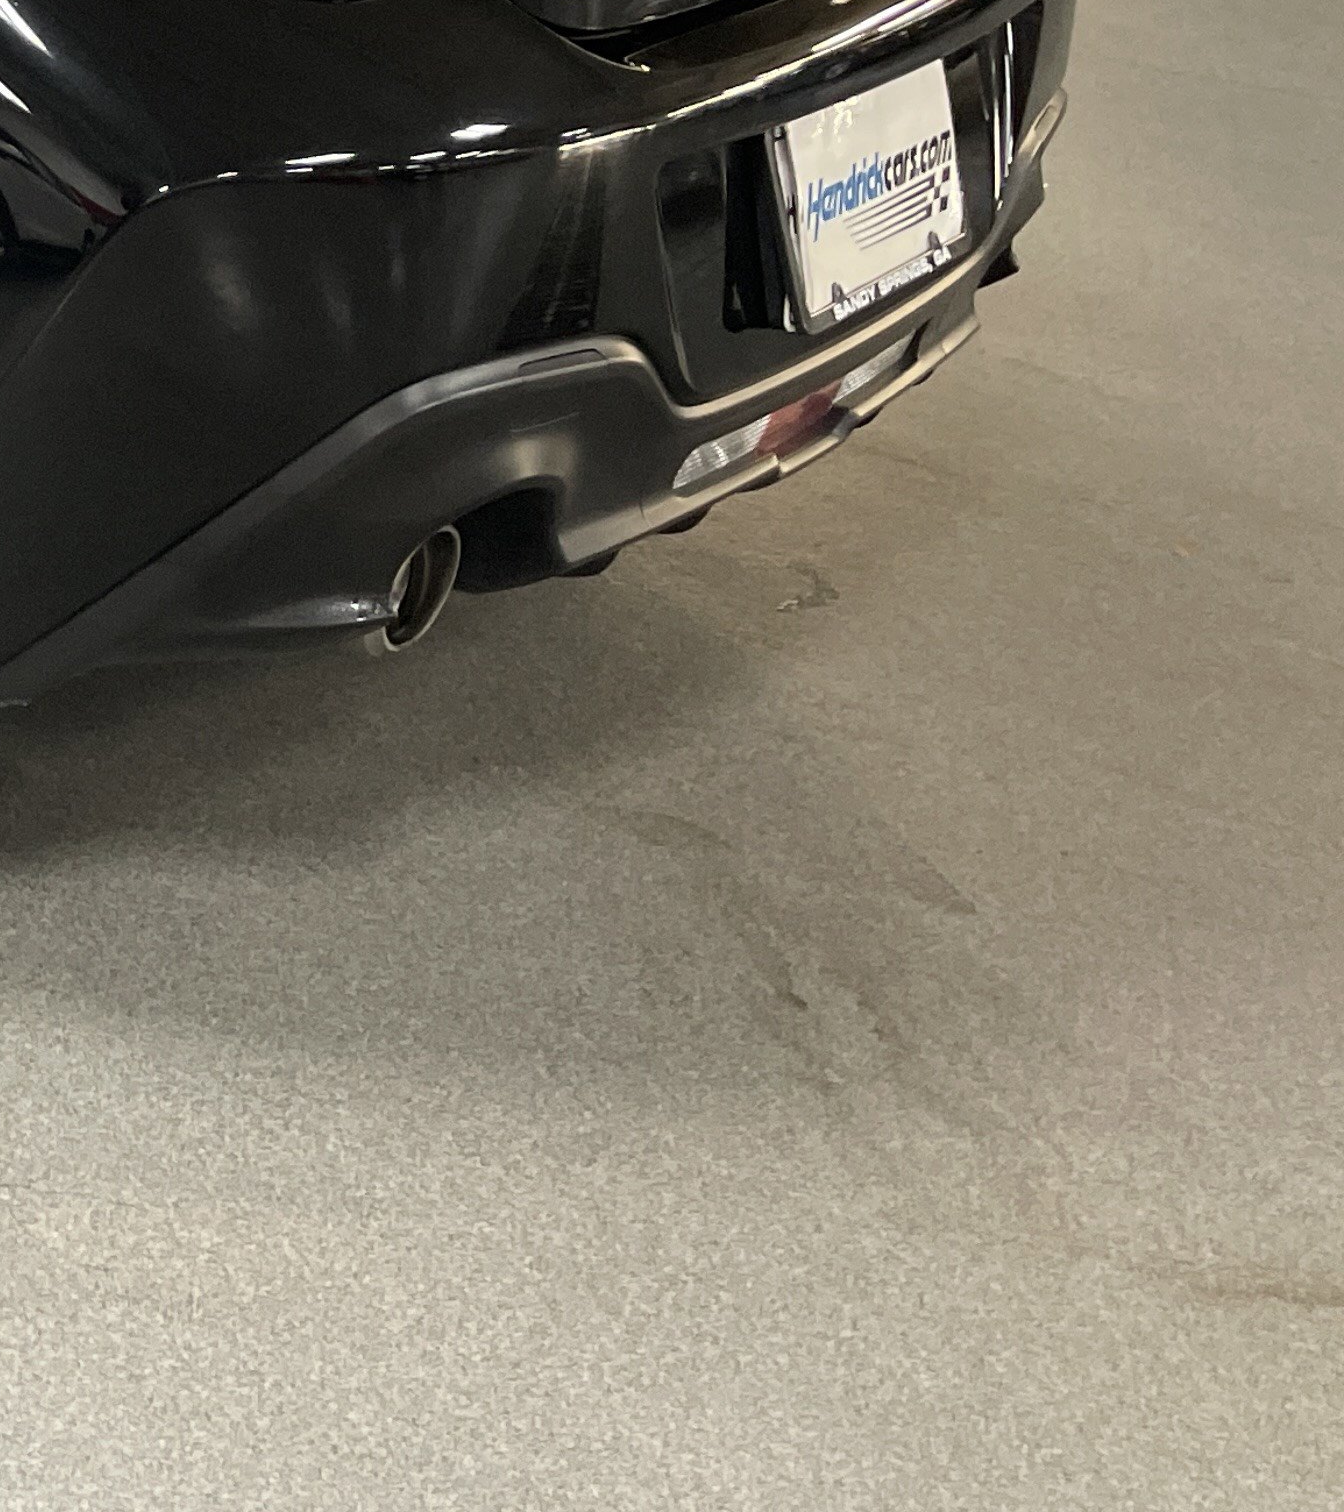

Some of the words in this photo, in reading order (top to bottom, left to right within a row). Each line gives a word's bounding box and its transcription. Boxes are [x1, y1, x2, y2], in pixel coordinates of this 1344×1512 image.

[807, 129, 952, 244] Hendrickcars.com
[832, 285, 876, 321] SANDY
[932, 243, 953, 267] GA
